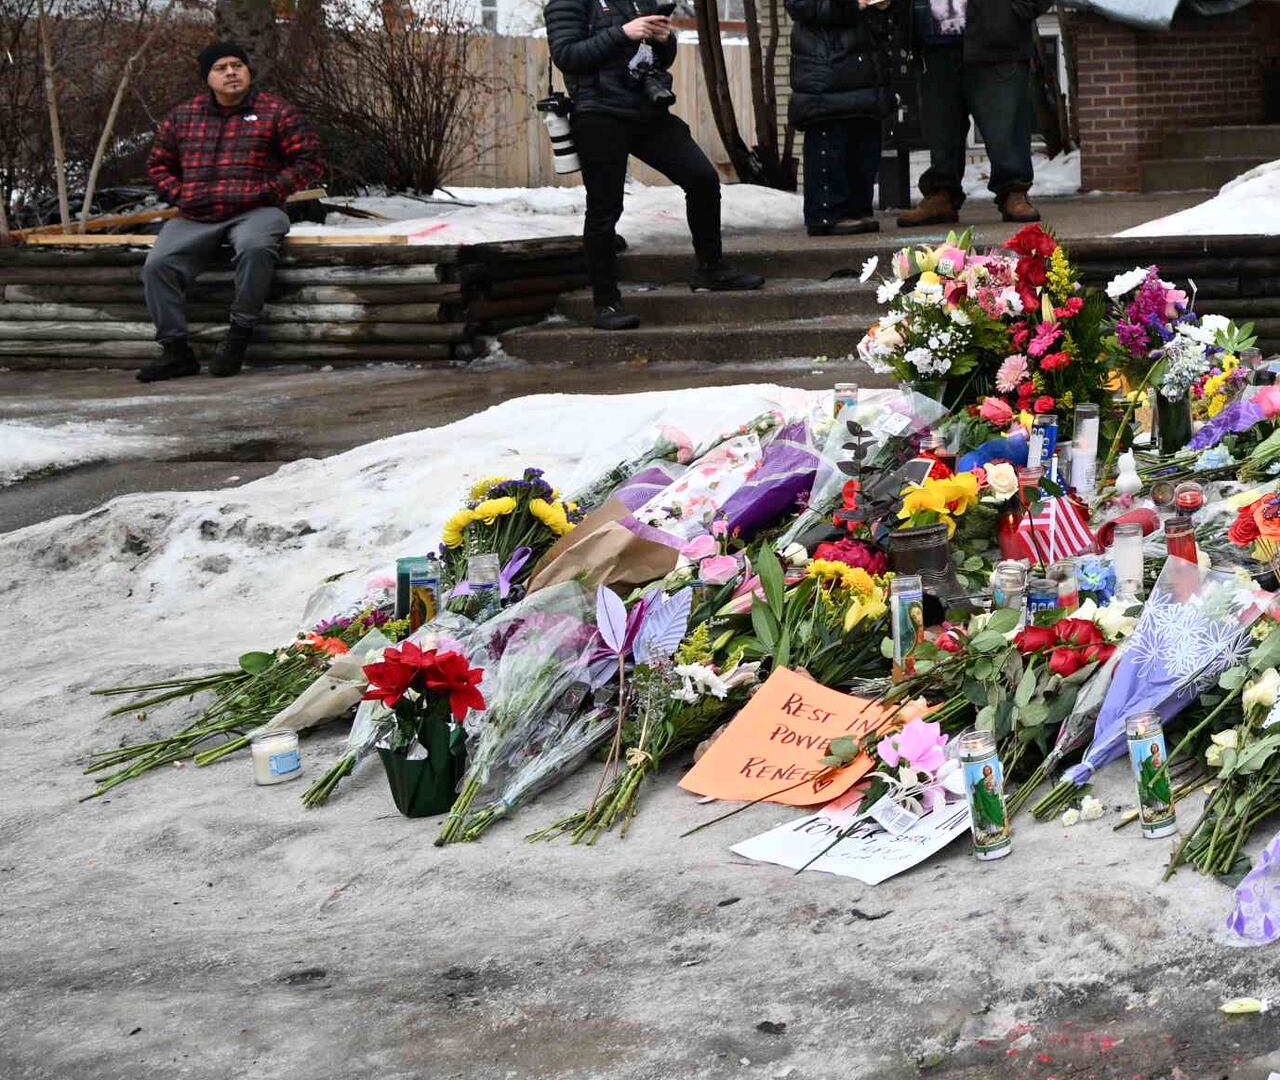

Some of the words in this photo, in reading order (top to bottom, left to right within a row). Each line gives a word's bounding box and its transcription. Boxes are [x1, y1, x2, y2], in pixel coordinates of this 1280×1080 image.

[780, 692, 838, 724] REST
[845, 717, 881, 733] IN
[769, 722, 834, 750] POWE
[739, 756, 818, 782] RENEE
